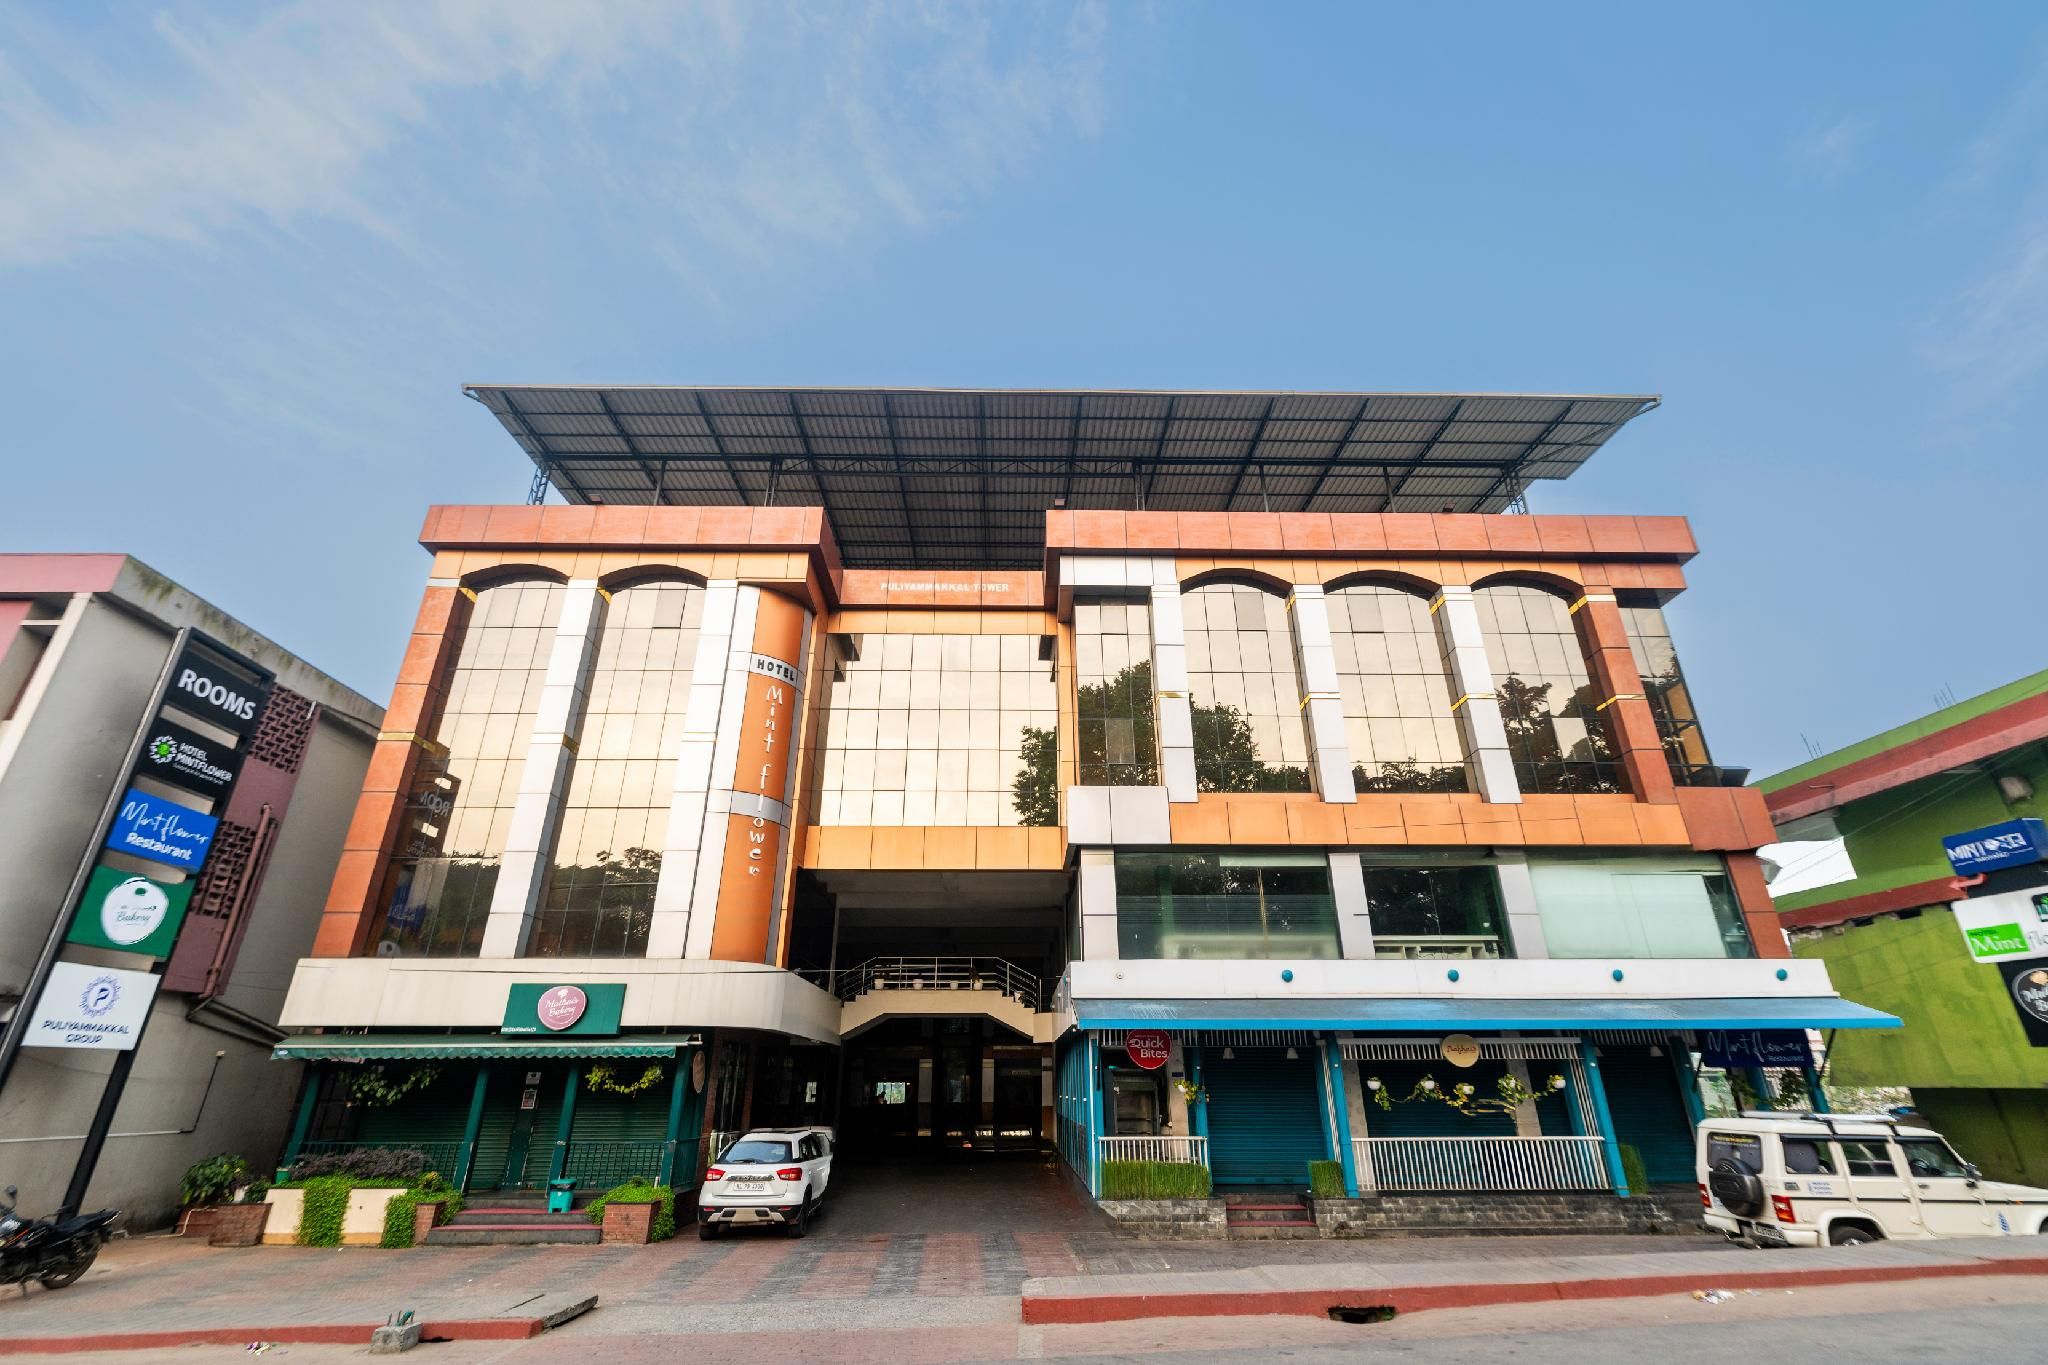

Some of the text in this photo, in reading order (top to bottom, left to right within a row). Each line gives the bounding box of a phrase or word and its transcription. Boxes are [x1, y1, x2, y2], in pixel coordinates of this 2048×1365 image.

[973, 583, 1009, 592] TOWER
[757, 659, 794, 681] HOTEL
[177, 668, 257, 720] ROOMS
[179, 742, 208, 761] HOTEL
[125, 832, 193, 861] Restaurant
[65, 1034, 103, 1044] GROUP
[1129, 1036, 1164, 1049] Quick
[1140, 1048, 1168, 1058] Bites
